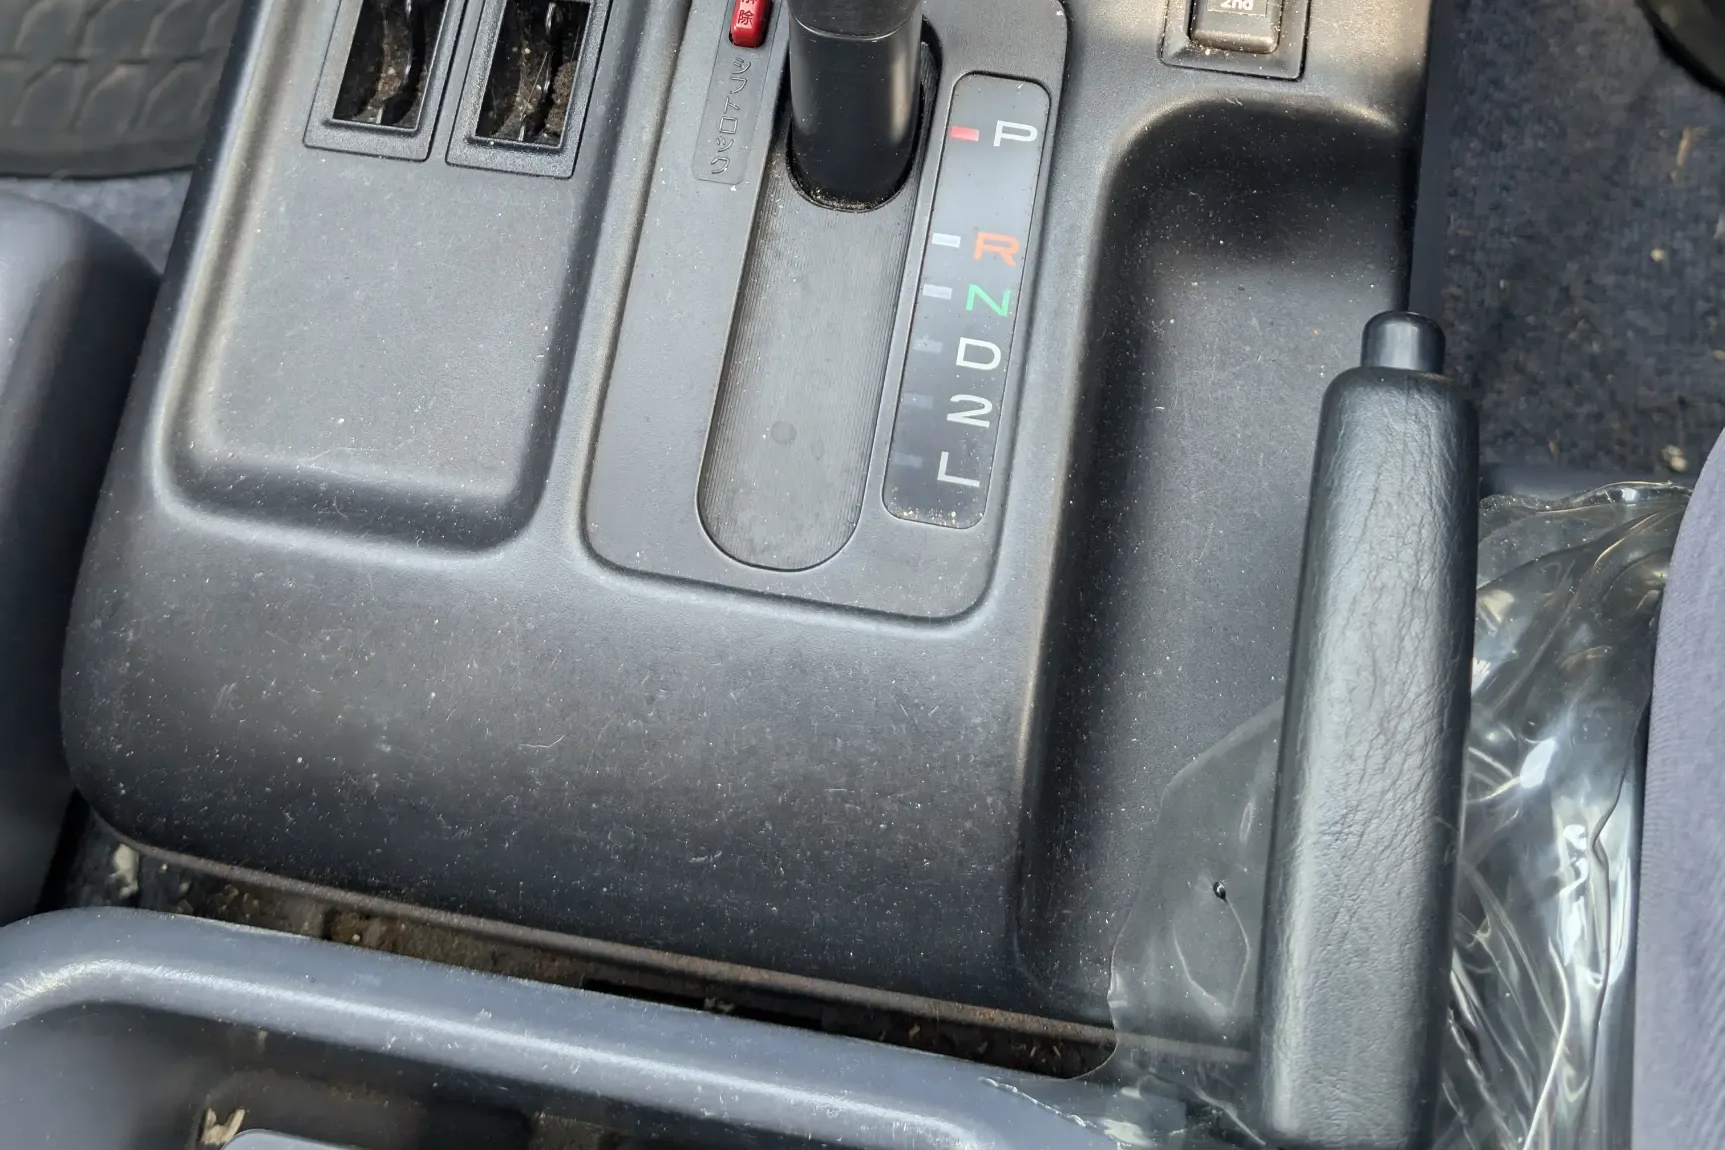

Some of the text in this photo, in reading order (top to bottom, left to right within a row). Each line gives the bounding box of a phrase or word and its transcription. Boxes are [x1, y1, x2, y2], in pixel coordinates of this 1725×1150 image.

[711, 57, 752, 174] シフトロック
[994, 120, 1038, 147] P
[973, 231, 1020, 266] R
[965, 283, 1011, 317] N
[955, 337, 1001, 371] D
[946, 393, 993, 428] 2
[937, 451, 980, 487] L
